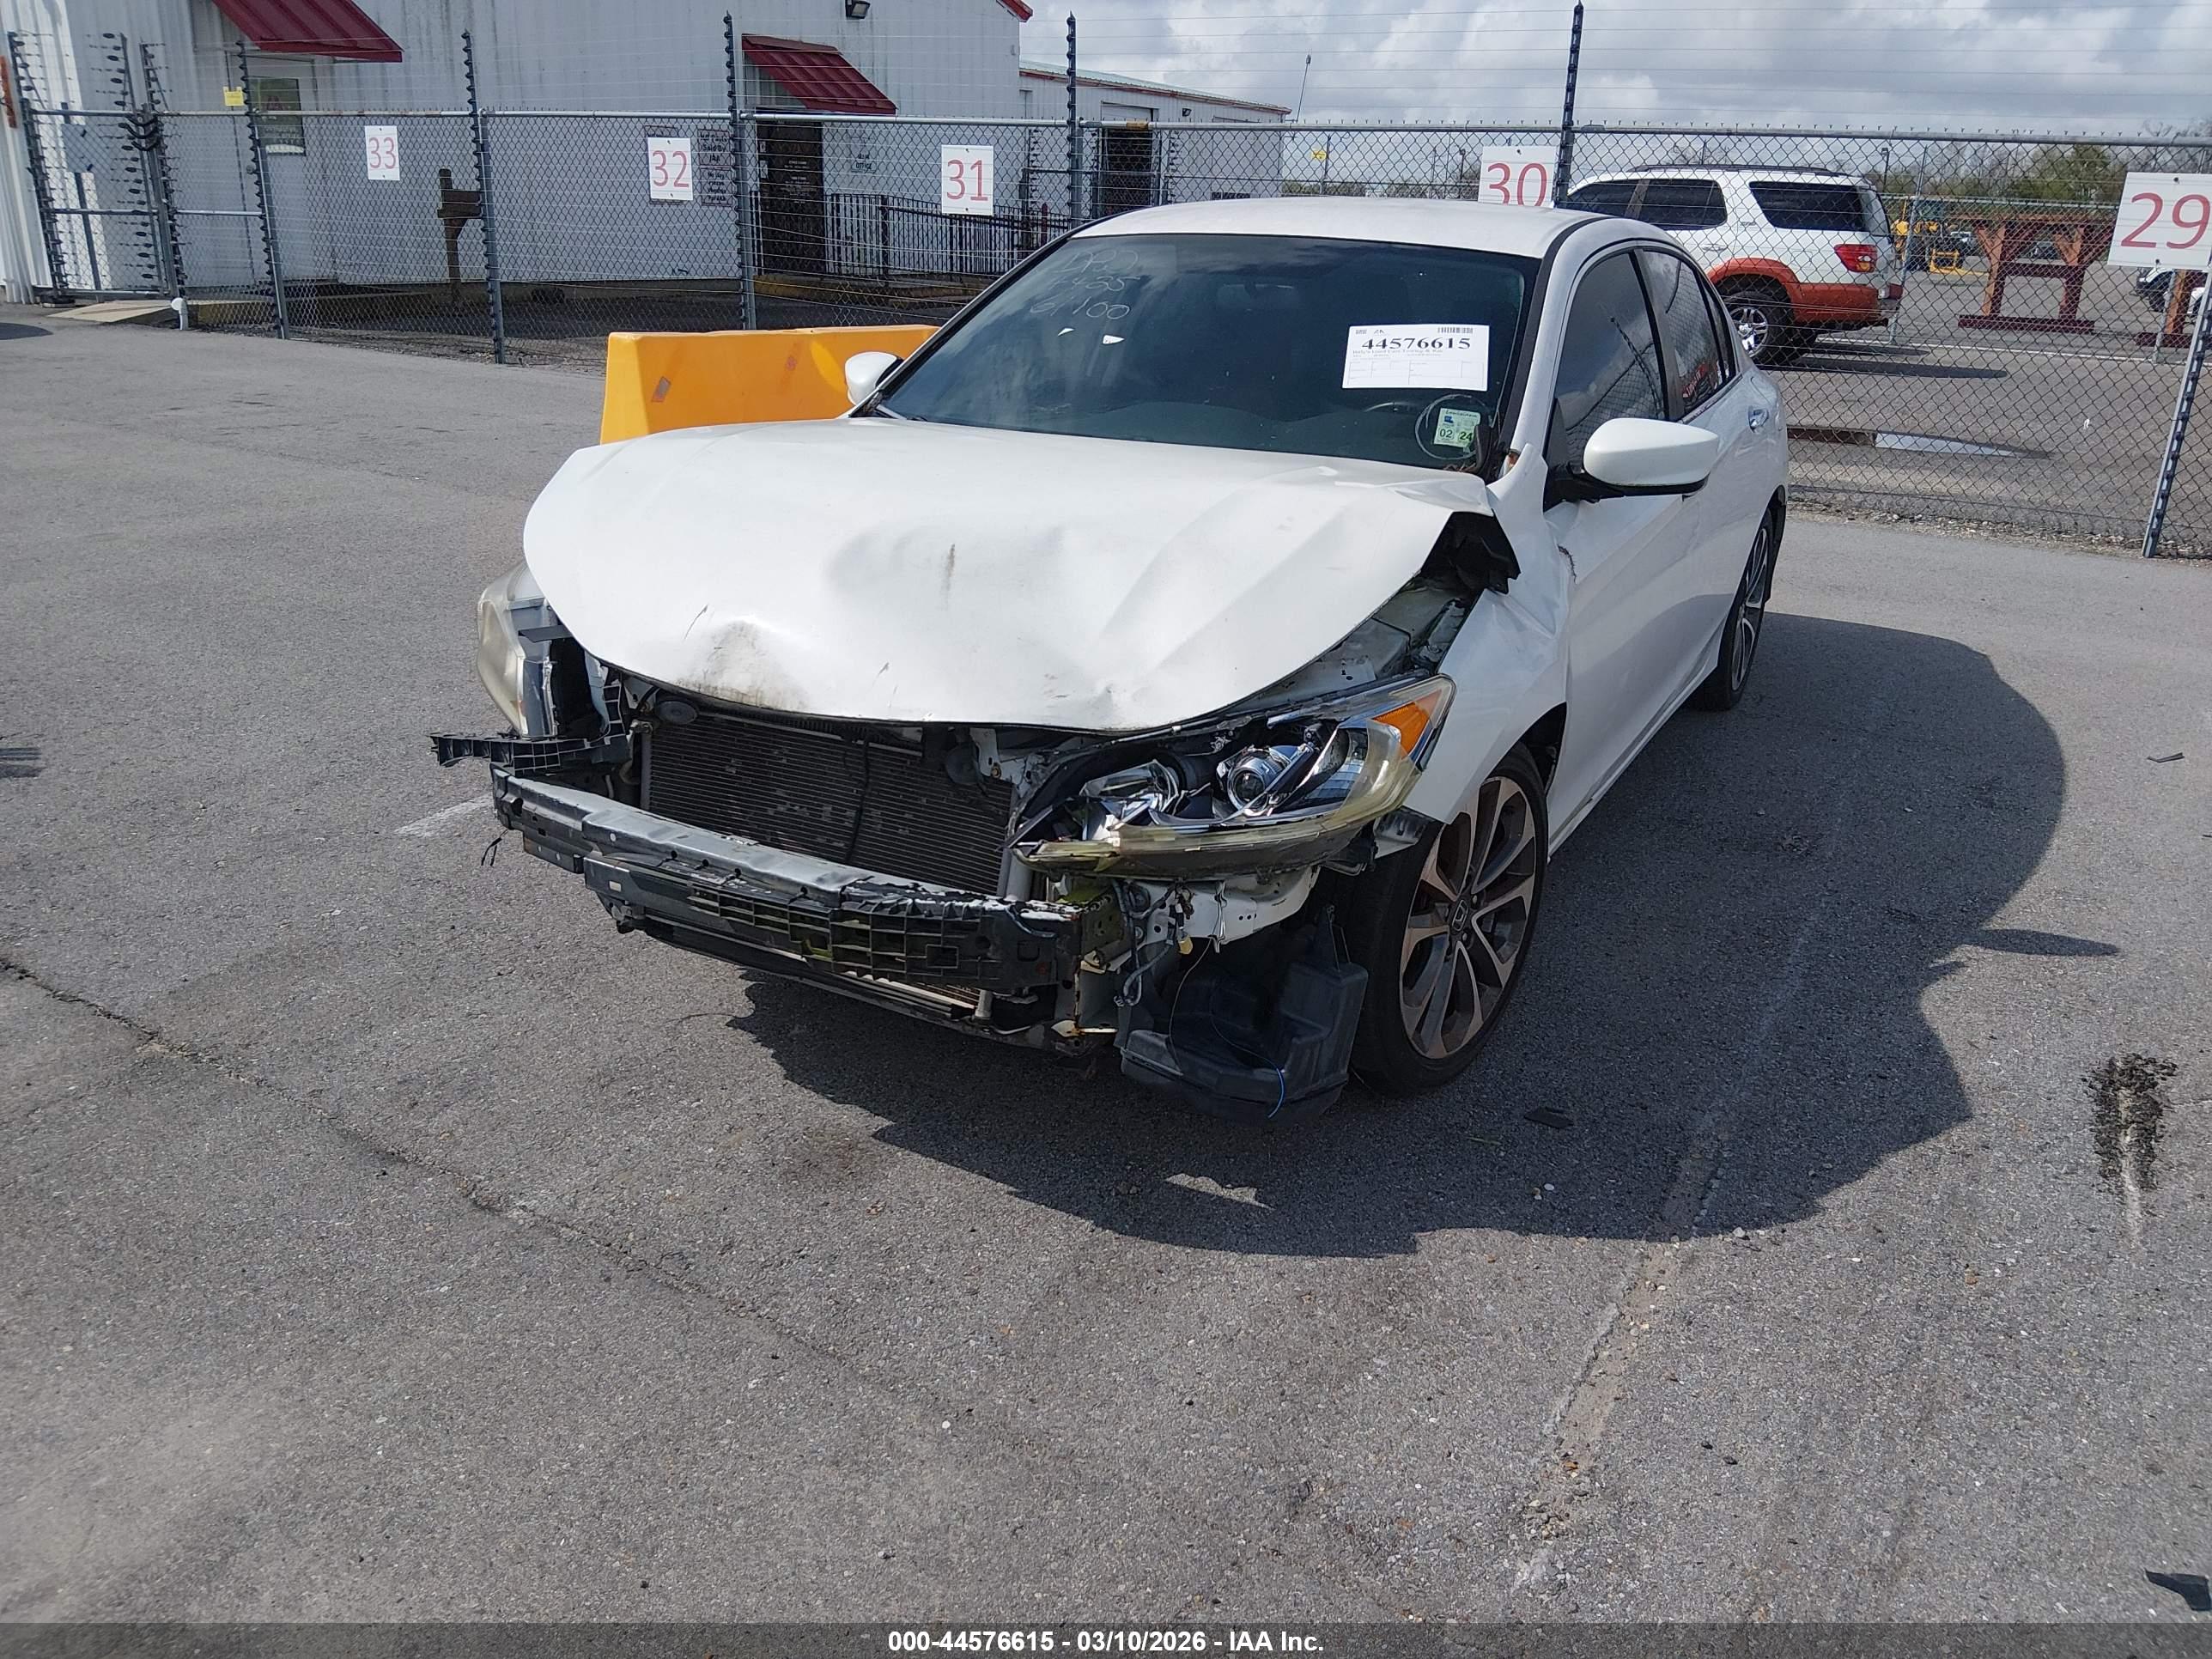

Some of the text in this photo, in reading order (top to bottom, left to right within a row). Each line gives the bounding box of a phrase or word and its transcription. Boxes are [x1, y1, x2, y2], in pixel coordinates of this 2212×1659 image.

[368, 137, 396, 169] 33
[652, 150, 690, 188] 32
[946, 159, 988, 202] 31
[1487, 162, 1547, 207] 30
[2120, 191, 2211, 249] 29
[1361, 337, 1471, 349] 44576615
[1439, 428, 1474, 441] 02 24
